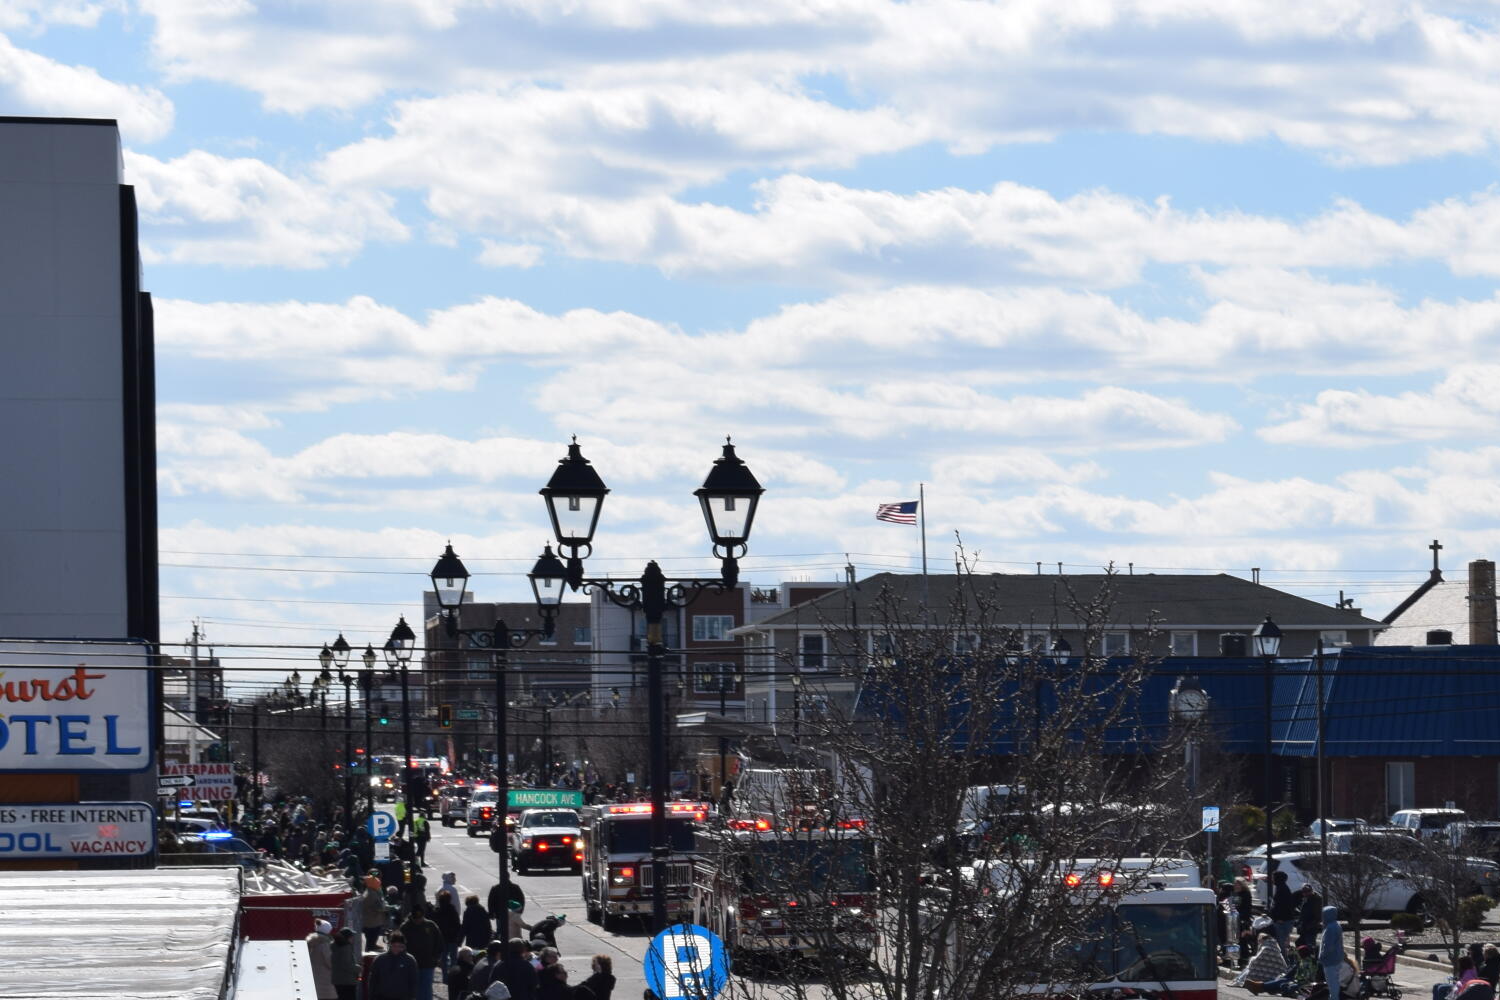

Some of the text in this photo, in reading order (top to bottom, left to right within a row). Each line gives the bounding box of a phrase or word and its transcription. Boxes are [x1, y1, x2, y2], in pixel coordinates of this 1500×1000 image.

[0, 664, 106, 702] urst
[0, 715, 142, 755] TEL
[181, 786, 232, 800] RKING
[515, 793, 576, 805] HANCOCK AVE
[31, 810, 66, 822] FREE
[71, 810, 146, 822] INTERNET
[372, 814, 390, 836] P
[71, 841, 146, 853] VACANCY
[663, 934, 713, 997] P
